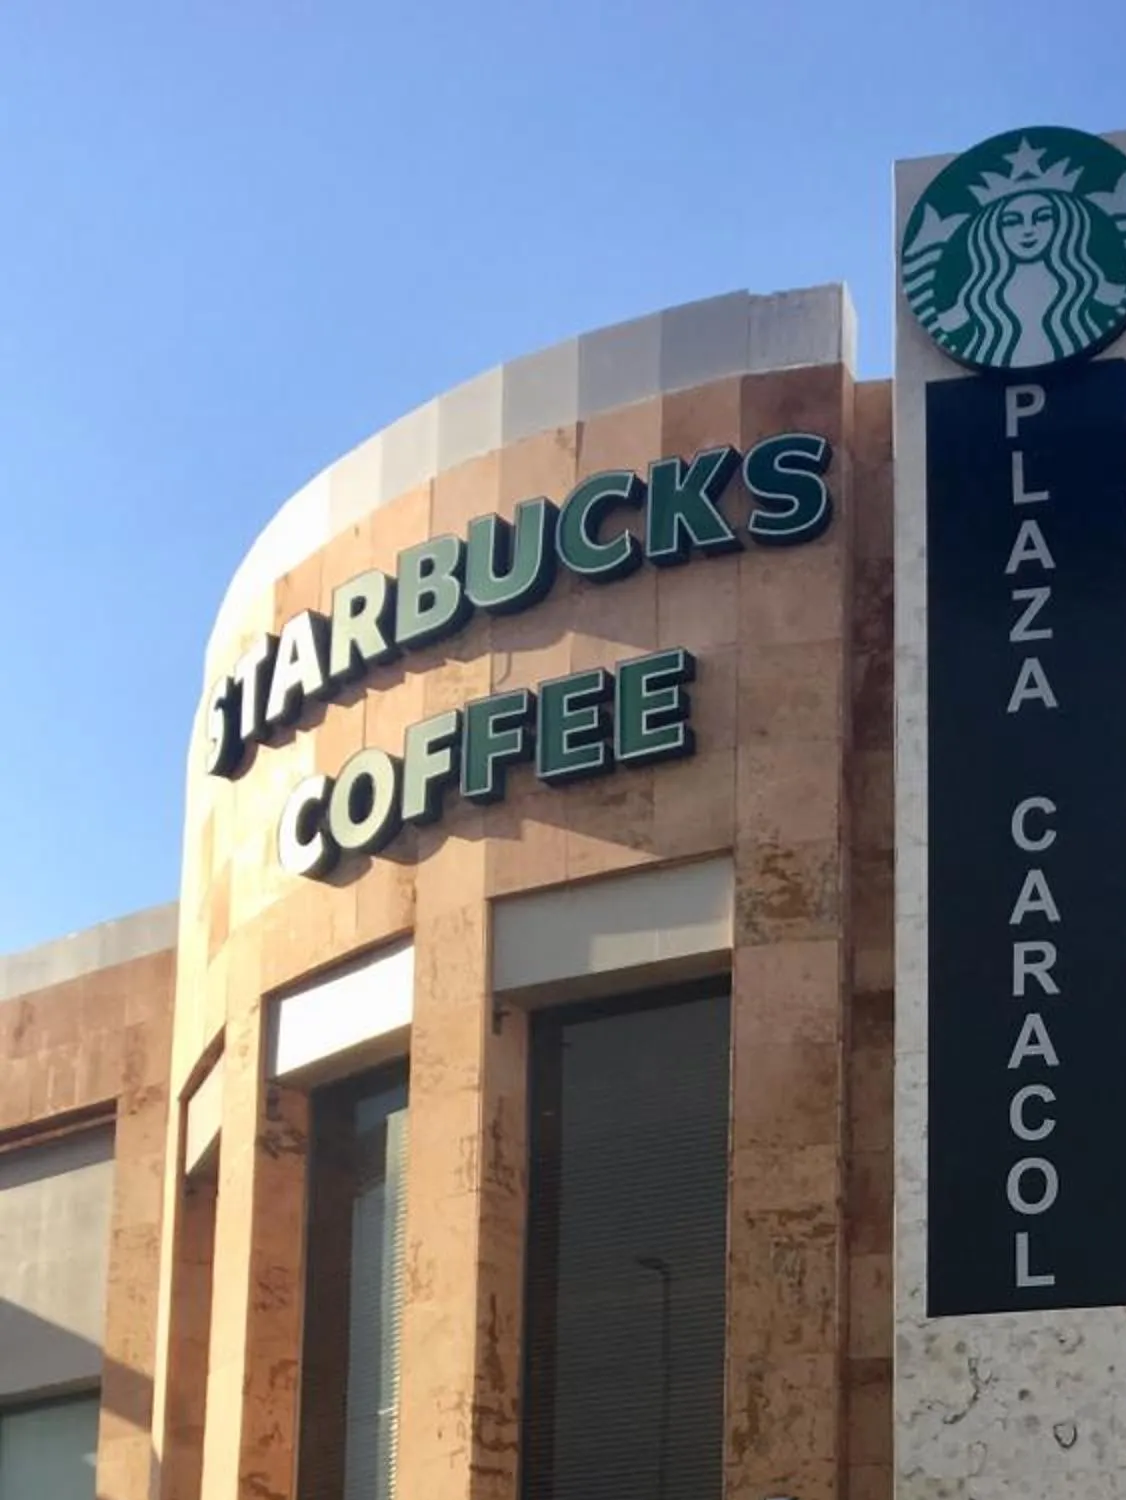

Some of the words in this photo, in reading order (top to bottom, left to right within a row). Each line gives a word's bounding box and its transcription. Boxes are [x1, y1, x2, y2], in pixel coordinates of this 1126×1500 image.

[204, 433, 834, 778] STARBUCKS
[1004, 383, 1059, 713] PLAZA
[277, 646, 696, 880] COFFEE
[1006, 797, 1061, 1288] CARACOL
